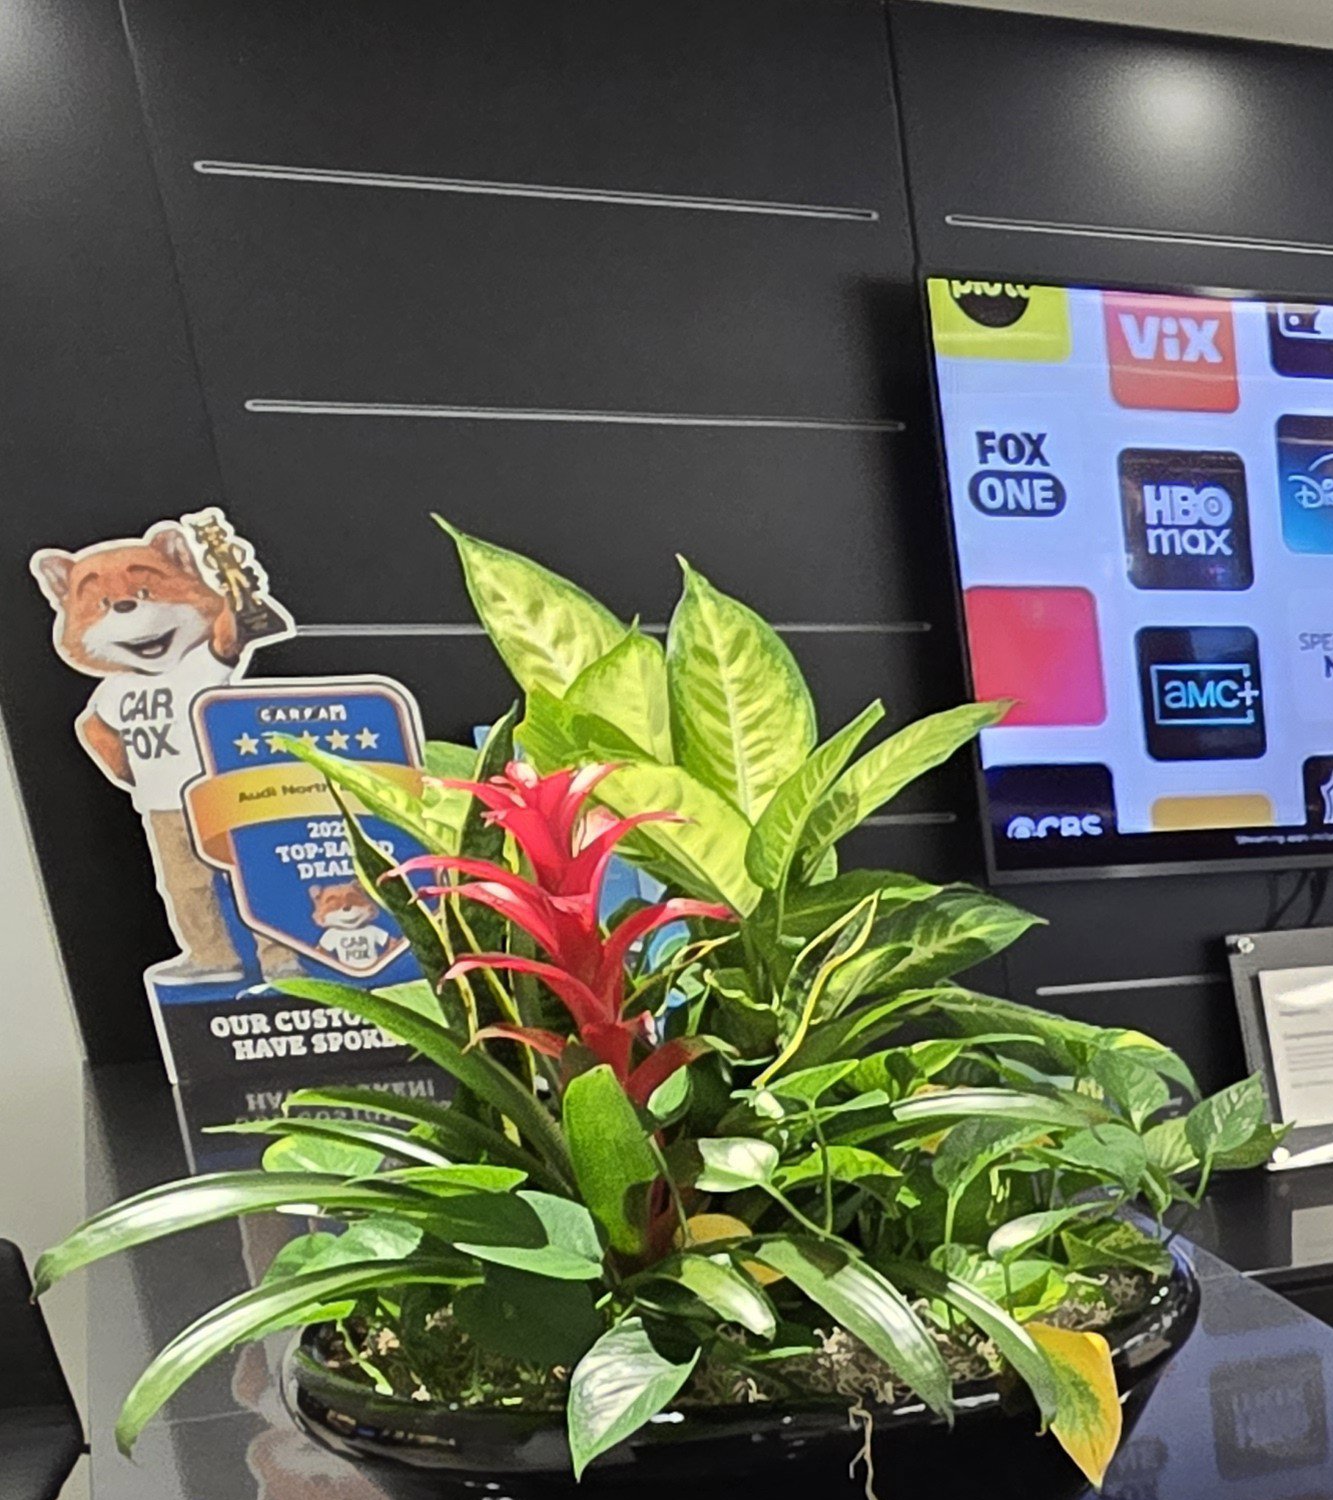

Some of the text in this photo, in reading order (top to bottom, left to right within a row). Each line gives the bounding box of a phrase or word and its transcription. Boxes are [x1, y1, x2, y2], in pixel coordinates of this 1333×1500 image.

[1118, 313, 1223, 363] ViX
[974, 430, 1051, 467] FOX
[977, 477, 1058, 511] ONE
[1142, 484, 1233, 527] HBO
[1146, 528, 1233, 556] max
[119, 687, 174, 723] CAR
[119, 723, 180, 760] FOX
[238, 786, 278, 803] Audi
[275, 840, 395, 864] TOP-RAD
[297, 860, 356, 880] DEAL
[210, 1012, 271, 1038] OUR
[231, 1036, 307, 1061] HAVE
